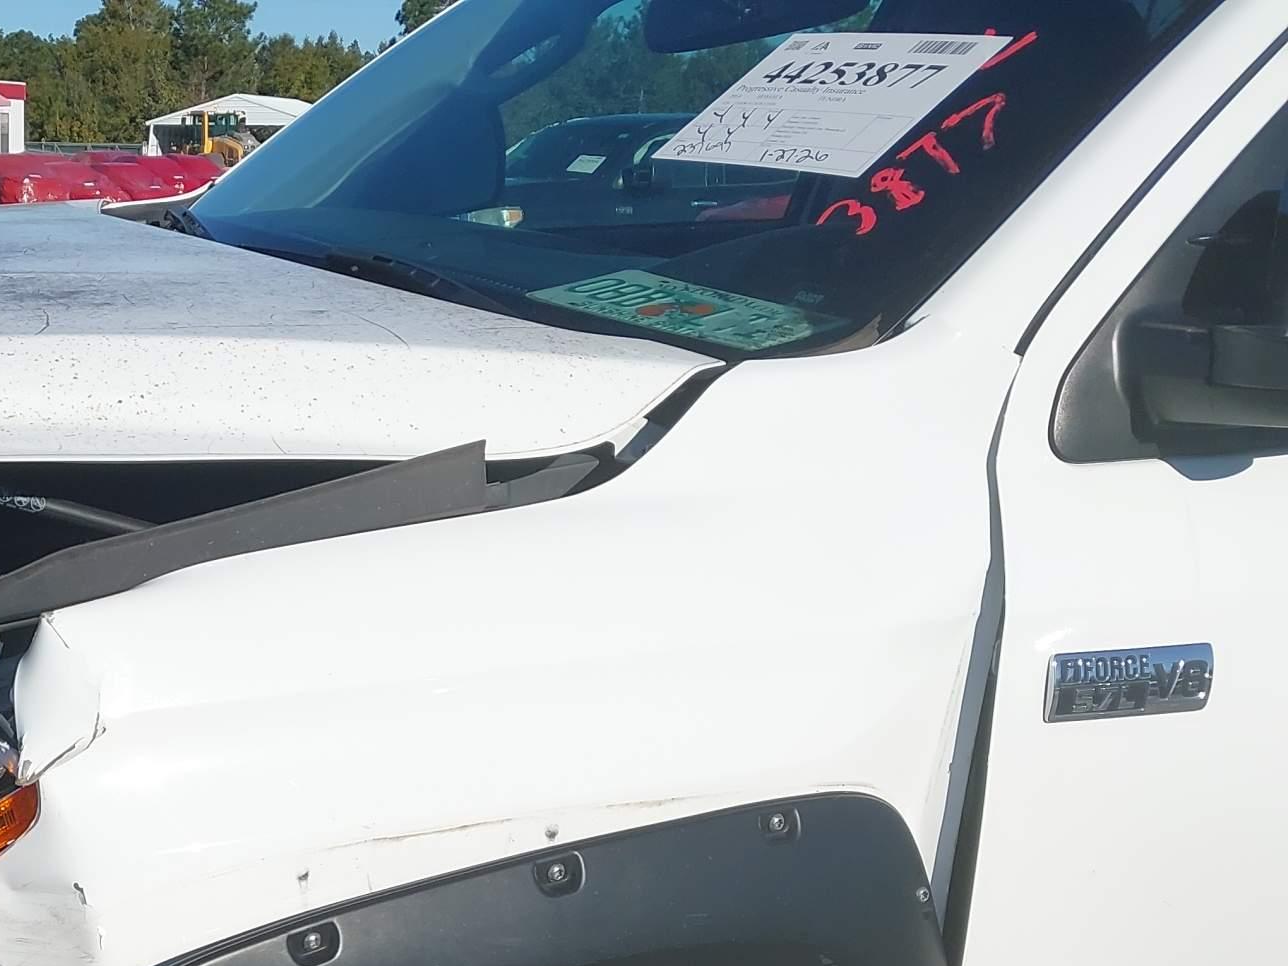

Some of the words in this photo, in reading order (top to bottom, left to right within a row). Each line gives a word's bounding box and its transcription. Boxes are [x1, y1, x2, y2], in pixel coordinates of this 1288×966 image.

[763, 60, 948, 88] 44253877
[736, 84, 785, 95] Progressive
[821, 86, 867, 96] Insurance
[1151, 660, 1209, 700] V8
